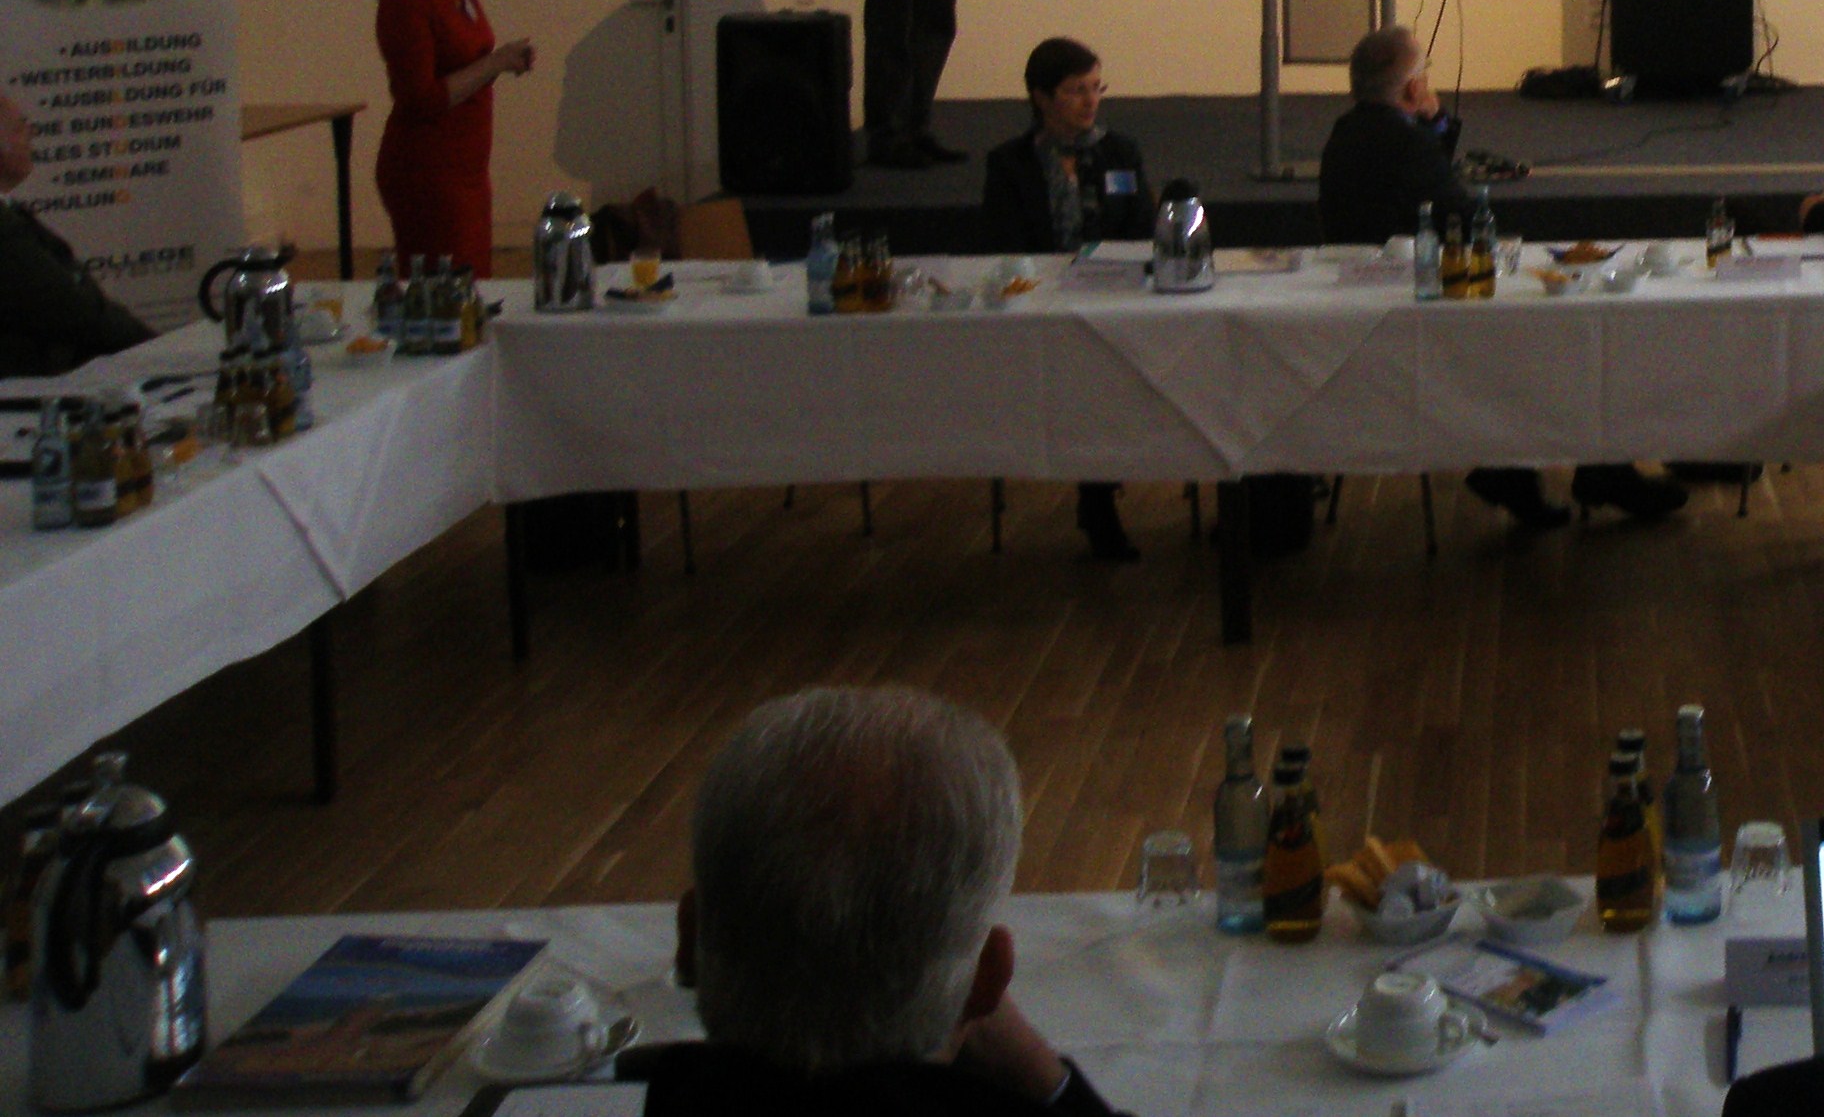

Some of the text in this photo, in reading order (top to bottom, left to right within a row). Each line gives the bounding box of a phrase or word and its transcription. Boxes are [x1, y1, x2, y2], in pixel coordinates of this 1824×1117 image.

[70, 33, 202, 57] AUSBILDUNG
[21, 58, 192, 86] WEITERBILDUNG
[51, 83, 183, 108] AUSBILDUNG
[70, 105, 214, 133] BUNDESWEHR
[31, 135, 182, 164] ALES STUDIUM
[63, 160, 170, 185] SEMINARE
[84, 245, 194, 269] OLLEGE
